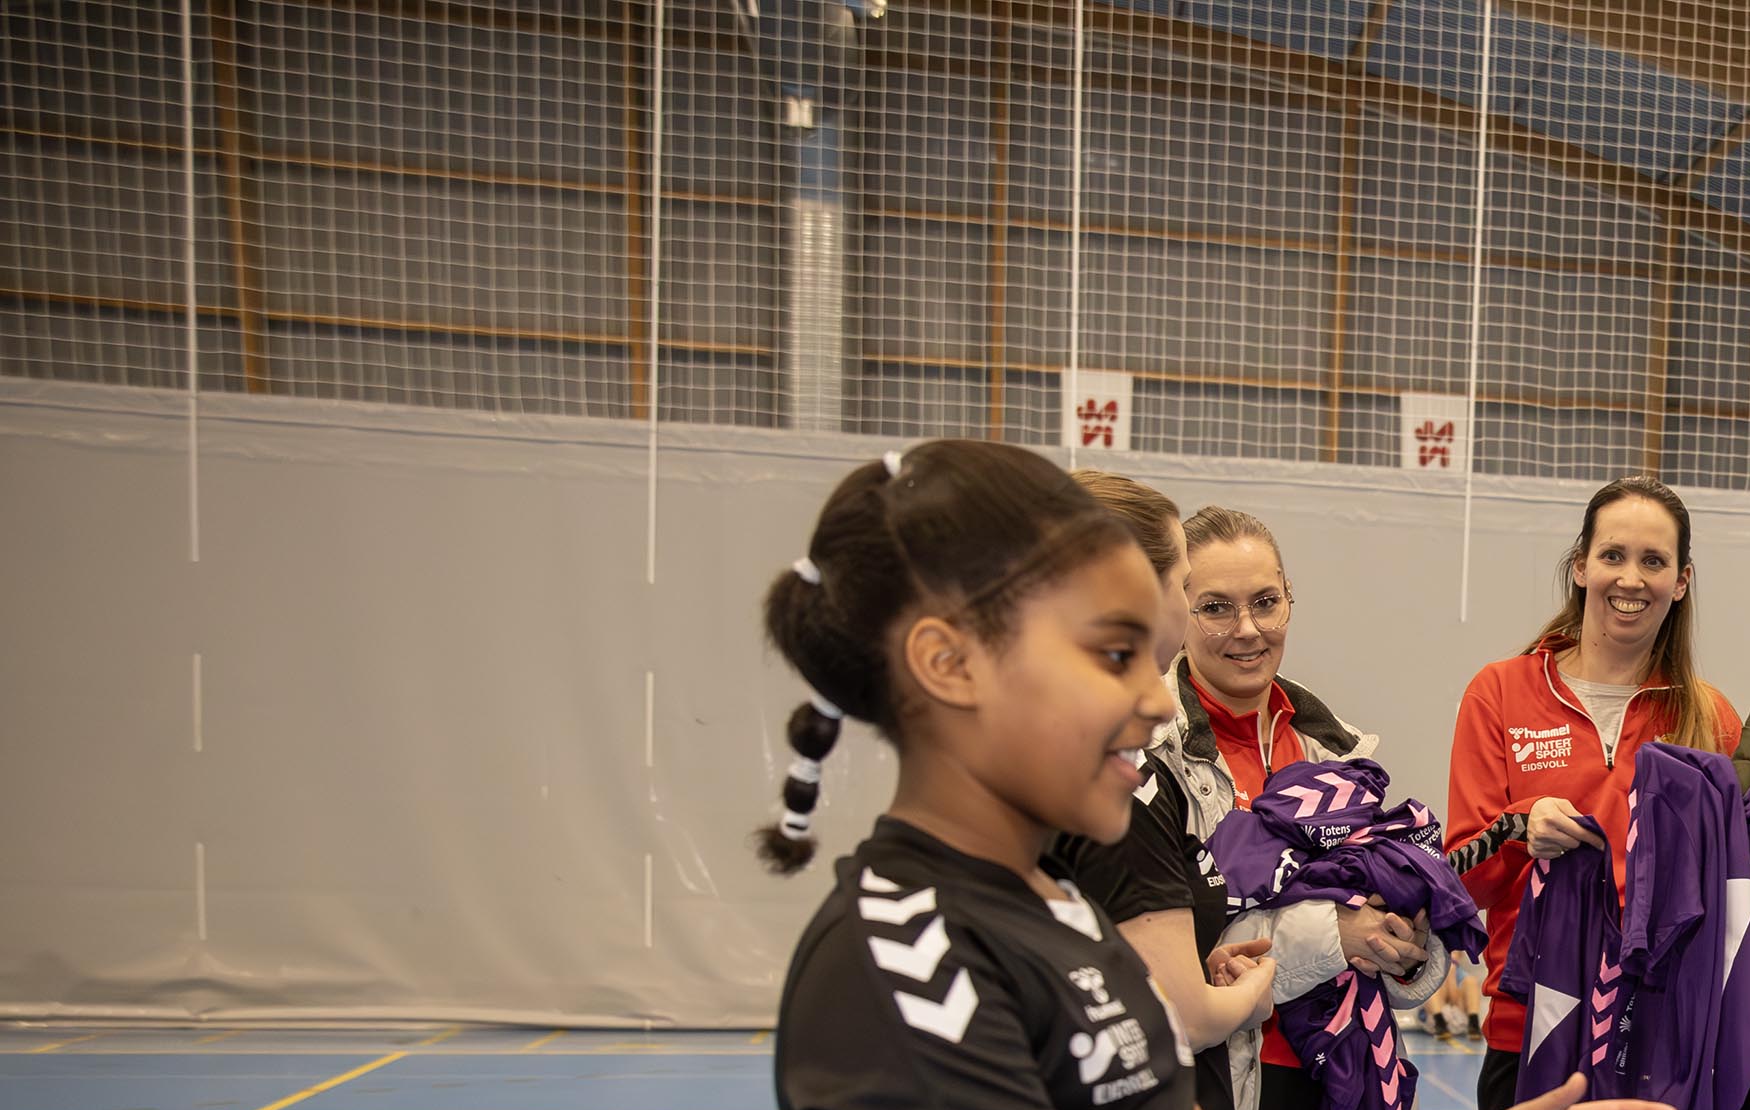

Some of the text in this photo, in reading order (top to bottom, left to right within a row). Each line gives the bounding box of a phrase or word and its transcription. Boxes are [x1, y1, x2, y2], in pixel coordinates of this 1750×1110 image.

[1524, 724, 1570, 739] hummel
[1535, 738, 1572, 751] INTER
[1535, 747, 1572, 760] SPORT
[1521, 760, 1568, 772] EIDSVOLL
[1319, 825, 1351, 837] Totens
